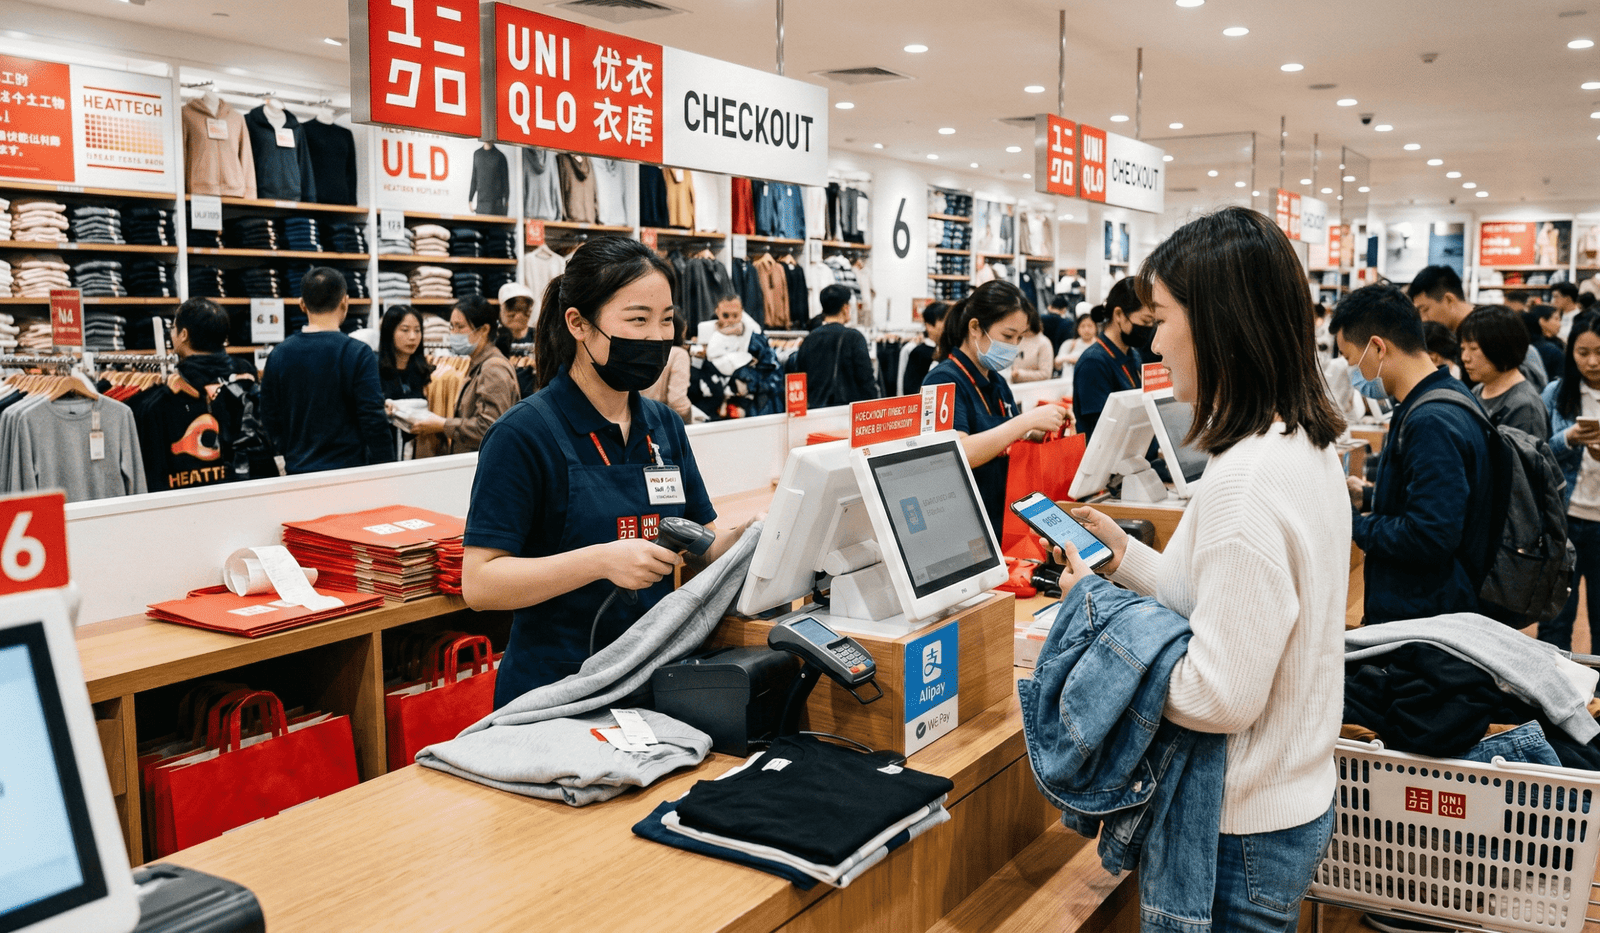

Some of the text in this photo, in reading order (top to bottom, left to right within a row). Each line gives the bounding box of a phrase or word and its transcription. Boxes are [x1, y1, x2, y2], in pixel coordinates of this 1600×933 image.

[508, 23, 570, 81] UNI
[593, 45, 653, 99] 优衣
[83, 94, 163, 117] HEATTECH
[508, 81, 576, 135] QLO
[684, 90, 813, 152] CHECKOUT
[593, 97, 653, 148] 衣库
[382, 139, 449, 181] ULD
[1083, 134, 1103, 164] UNI
[1083, 164, 1104, 195] QLO
[1112, 158, 1159, 191] CHECKOUT
[892, 197, 911, 259] 6
[940, 391, 949, 424] 6
[643, 517, 657, 527] UNI
[643, 527, 659, 538] QLO
[1, 511, 47, 582] 6
[919, 681, 946, 704] Alipay
[939, 711, 951, 723] Pay
[1441, 794, 1461, 806] UNI
[1441, 804, 1463, 816] QLO
